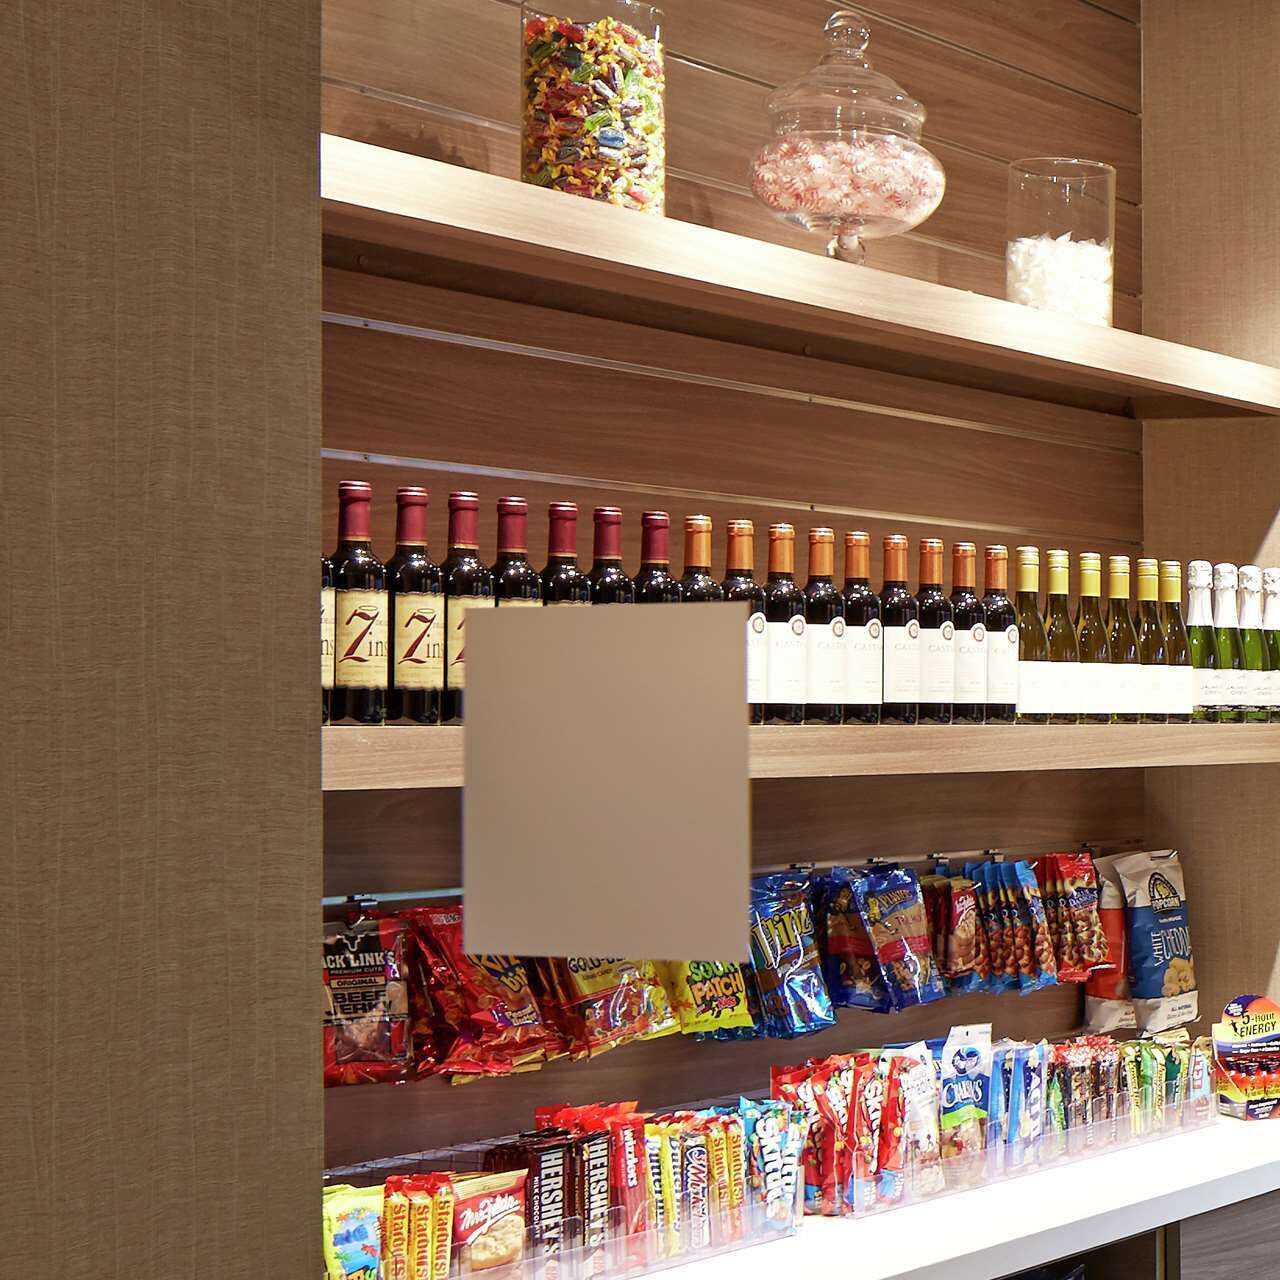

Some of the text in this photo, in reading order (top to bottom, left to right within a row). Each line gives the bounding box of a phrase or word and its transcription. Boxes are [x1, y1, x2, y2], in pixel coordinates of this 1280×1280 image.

[1151, 931, 1163, 967] WHITE
[323, 956, 345, 969] ACK
[336, 978, 378, 986] ORIGINAL
[690, 972, 742, 1005] PATCH
[334, 990, 386, 1003] BEEF
[1240, 1020, 1278, 1038] ENERGY
[540, 1152, 564, 1255] HERSHEY'S
[589, 1143, 607, 1248] HERSHEY'S
